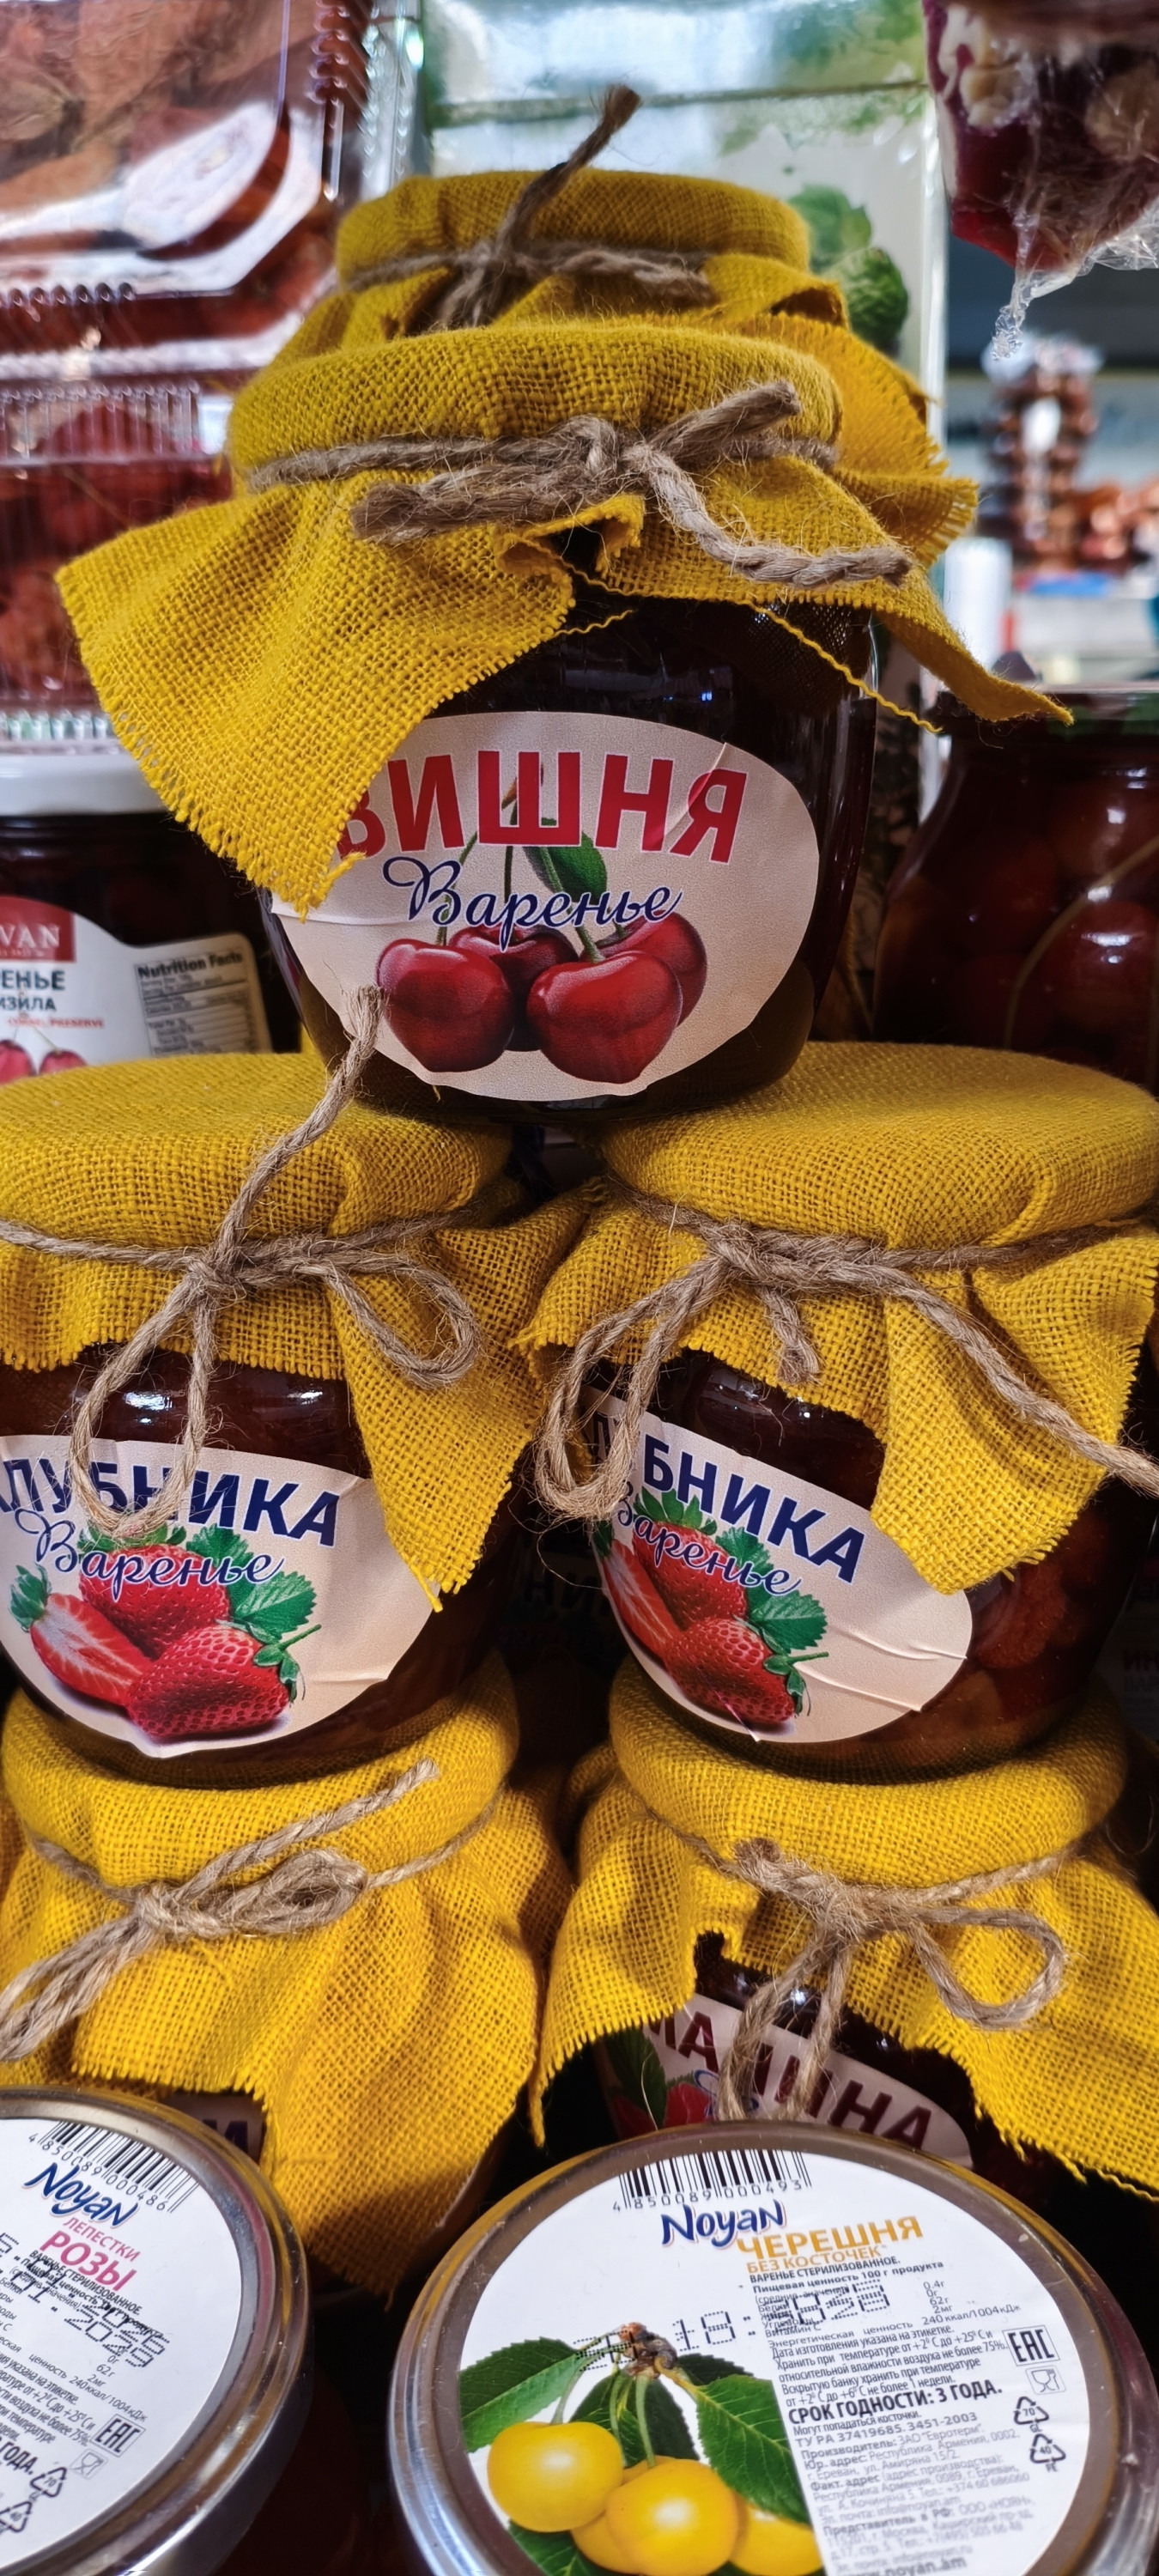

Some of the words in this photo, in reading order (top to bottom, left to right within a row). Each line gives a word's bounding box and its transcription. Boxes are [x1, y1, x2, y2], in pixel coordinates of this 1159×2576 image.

[383, 856, 684, 951] Варенье
[0, 969, 65, 991] ЕНЬЕ
[138, 957, 207, 978] Nutrition
[209, 952, 242, 968] Facts
[15, 1507, 284, 1602] Варенье
[22, 2161, 140, 2227] Noyan
[63, 2217, 141, 2263] ЛЕПЕСТКИ
[660, 2198, 786, 2248] Noyan
[737, 2215, 923, 2261] ЧЕРЕШНЯ
[39, 2230, 137, 2292] РОЗЫ
[746, 2259, 780, 2274] БЕЗ
[784, 2245, 881, 2270] КОСТОЧЕК
[749, 2269, 795, 2284] ВАРЕНЬЕ
[797, 2255, 901, 2278] СТЕРИЛИЗОВАННОЕ.
[753, 2281, 805, 2295] Пищевая
[807, 2274, 859, 2288] ценность
[861, 2270, 881, 2281] 100
[891, 2260, 944, 2275] продукта
[768, 2330, 855, 2348] Энергетическая
[863, 2321, 913, 2335] ценность
[773, 2346, 794, 2360] Дата
[796, 2338, 859, 2356] изготовления
[860, 2332, 898, 2348] указана
[899, 2330, 911, 2341] на
[912, 2324, 955, 2339] этикетке.
[28, 2354, 68, 2379] ценность
[774, 2357, 816, 2372] Хранить
[817, 2354, 835, 2366] при
[840, 2344, 900, 2362] температуре
[901, 2342, 912, 2352] от
[940, 2336, 952, 2348] до
[779, 2363, 849, 2383] относительной
[851, 2356, 901, 2373] влажности
[903, 2350, 942, 2367] воздуха
[943, 2348, 954, 2358] не
[955, 2342, 983, 2356] более
[781, 2380, 830, 2397] Вскрытую
[830, 2375, 859, 2391] банку
[860, 2369, 900, 2385] хранить
[901, 2366, 919, 2380] при
[920, 2356, 981, 2376] температуре
[786, 2397, 796, 2408] от
[827, 2391, 838, 2403] до
[868, 2385, 879, 2396] не
[880, 2379, 908, 2394] более
[918, 2374, 956, 2389] недели.
[787, 2403, 834, 2425] СРОК
[836, 2389, 935, 2419] ГОДНОСТИ:
[935, 2387, 948, 2403] 3
[950, 2379, 1003, 2401] ГОДА.
[1022, 2407, 1035, 2416] 70
[793, 2422, 822, 2437] Могут
[823, 2417, 877, 2432] попадаться
[877, 2410, 922, 2424] косточки.
[795, 2436, 814, 2447] ТУ
[801, 2438, 898, 2461] Производитель:
[830, 2454, 868, 2469] адрес:
[869, 2442, 933, 2462] Республика
[846, 2474, 880, 2488] адрес
